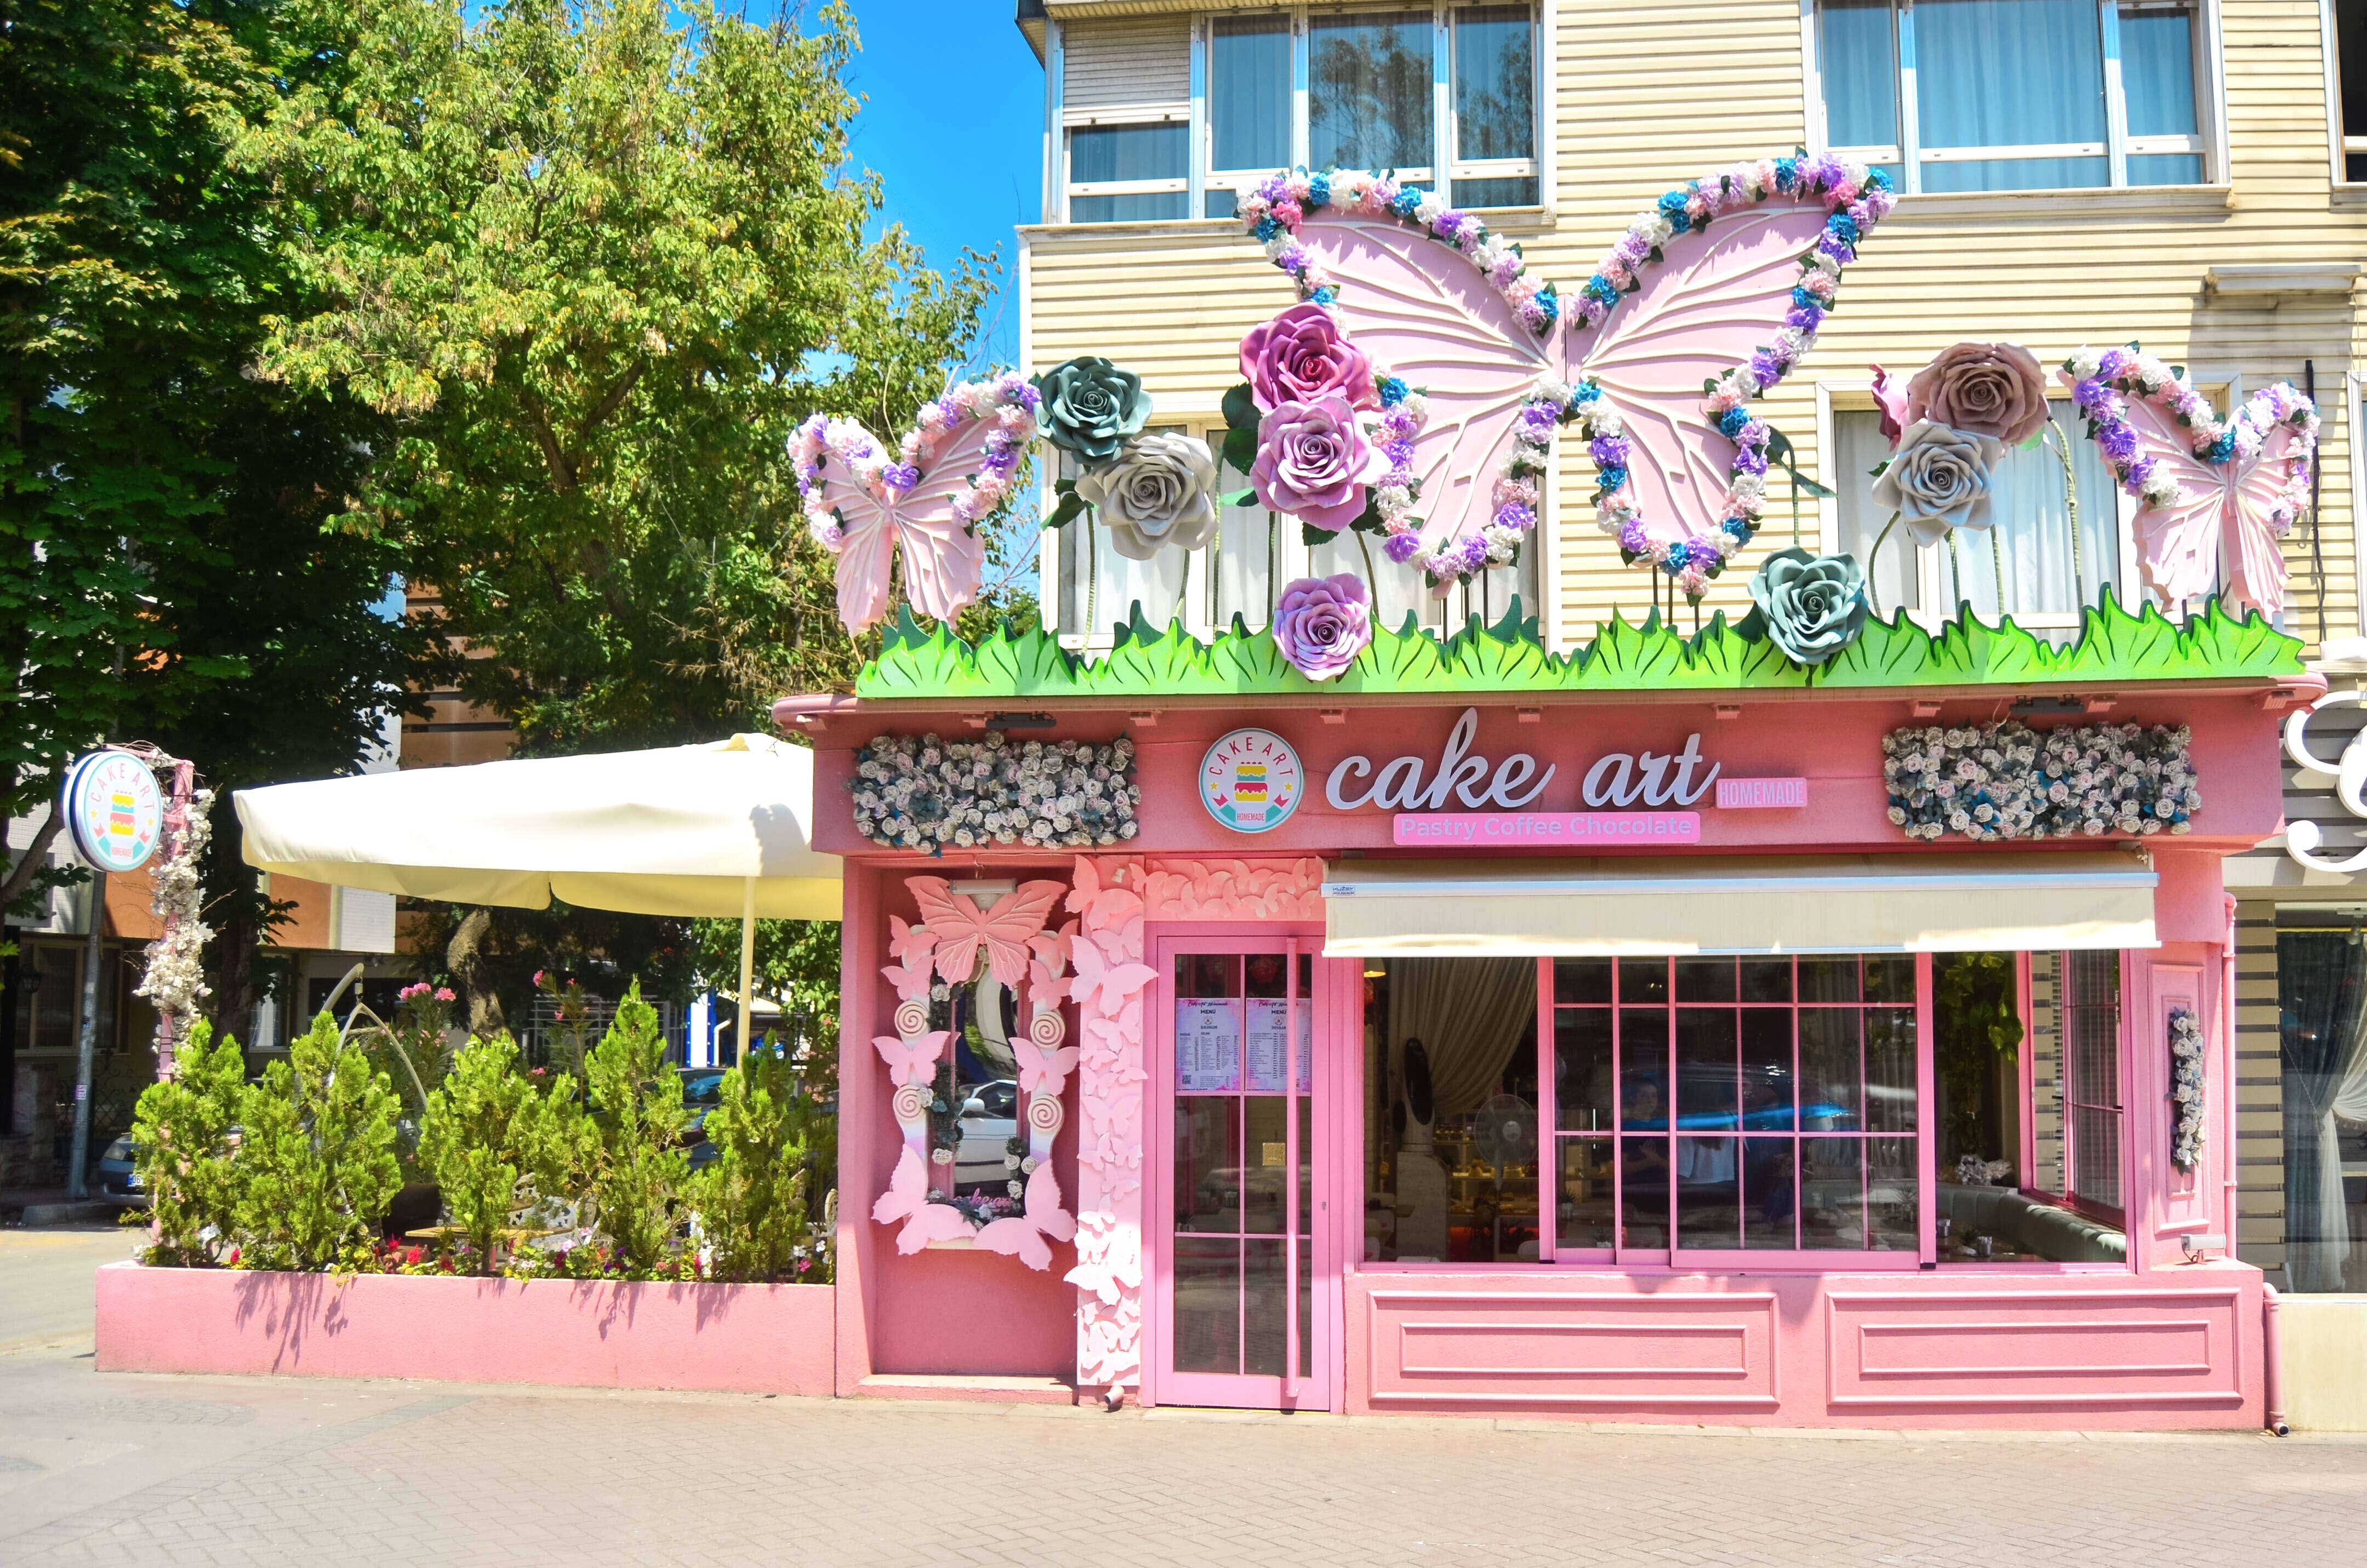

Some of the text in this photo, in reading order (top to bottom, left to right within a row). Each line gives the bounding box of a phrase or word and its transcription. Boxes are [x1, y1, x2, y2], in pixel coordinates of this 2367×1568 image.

[1209, 737, 1293, 776] CAKE ART
[1326, 707, 1720, 809] cake art
[90, 763, 155, 809] CAKE ART
[1719, 780, 1805, 806] HOMEMADE
[1236, 813, 1265, 821] HOMEMADE
[1401, 815, 1693, 841] Pastry Coffee Chocolate
